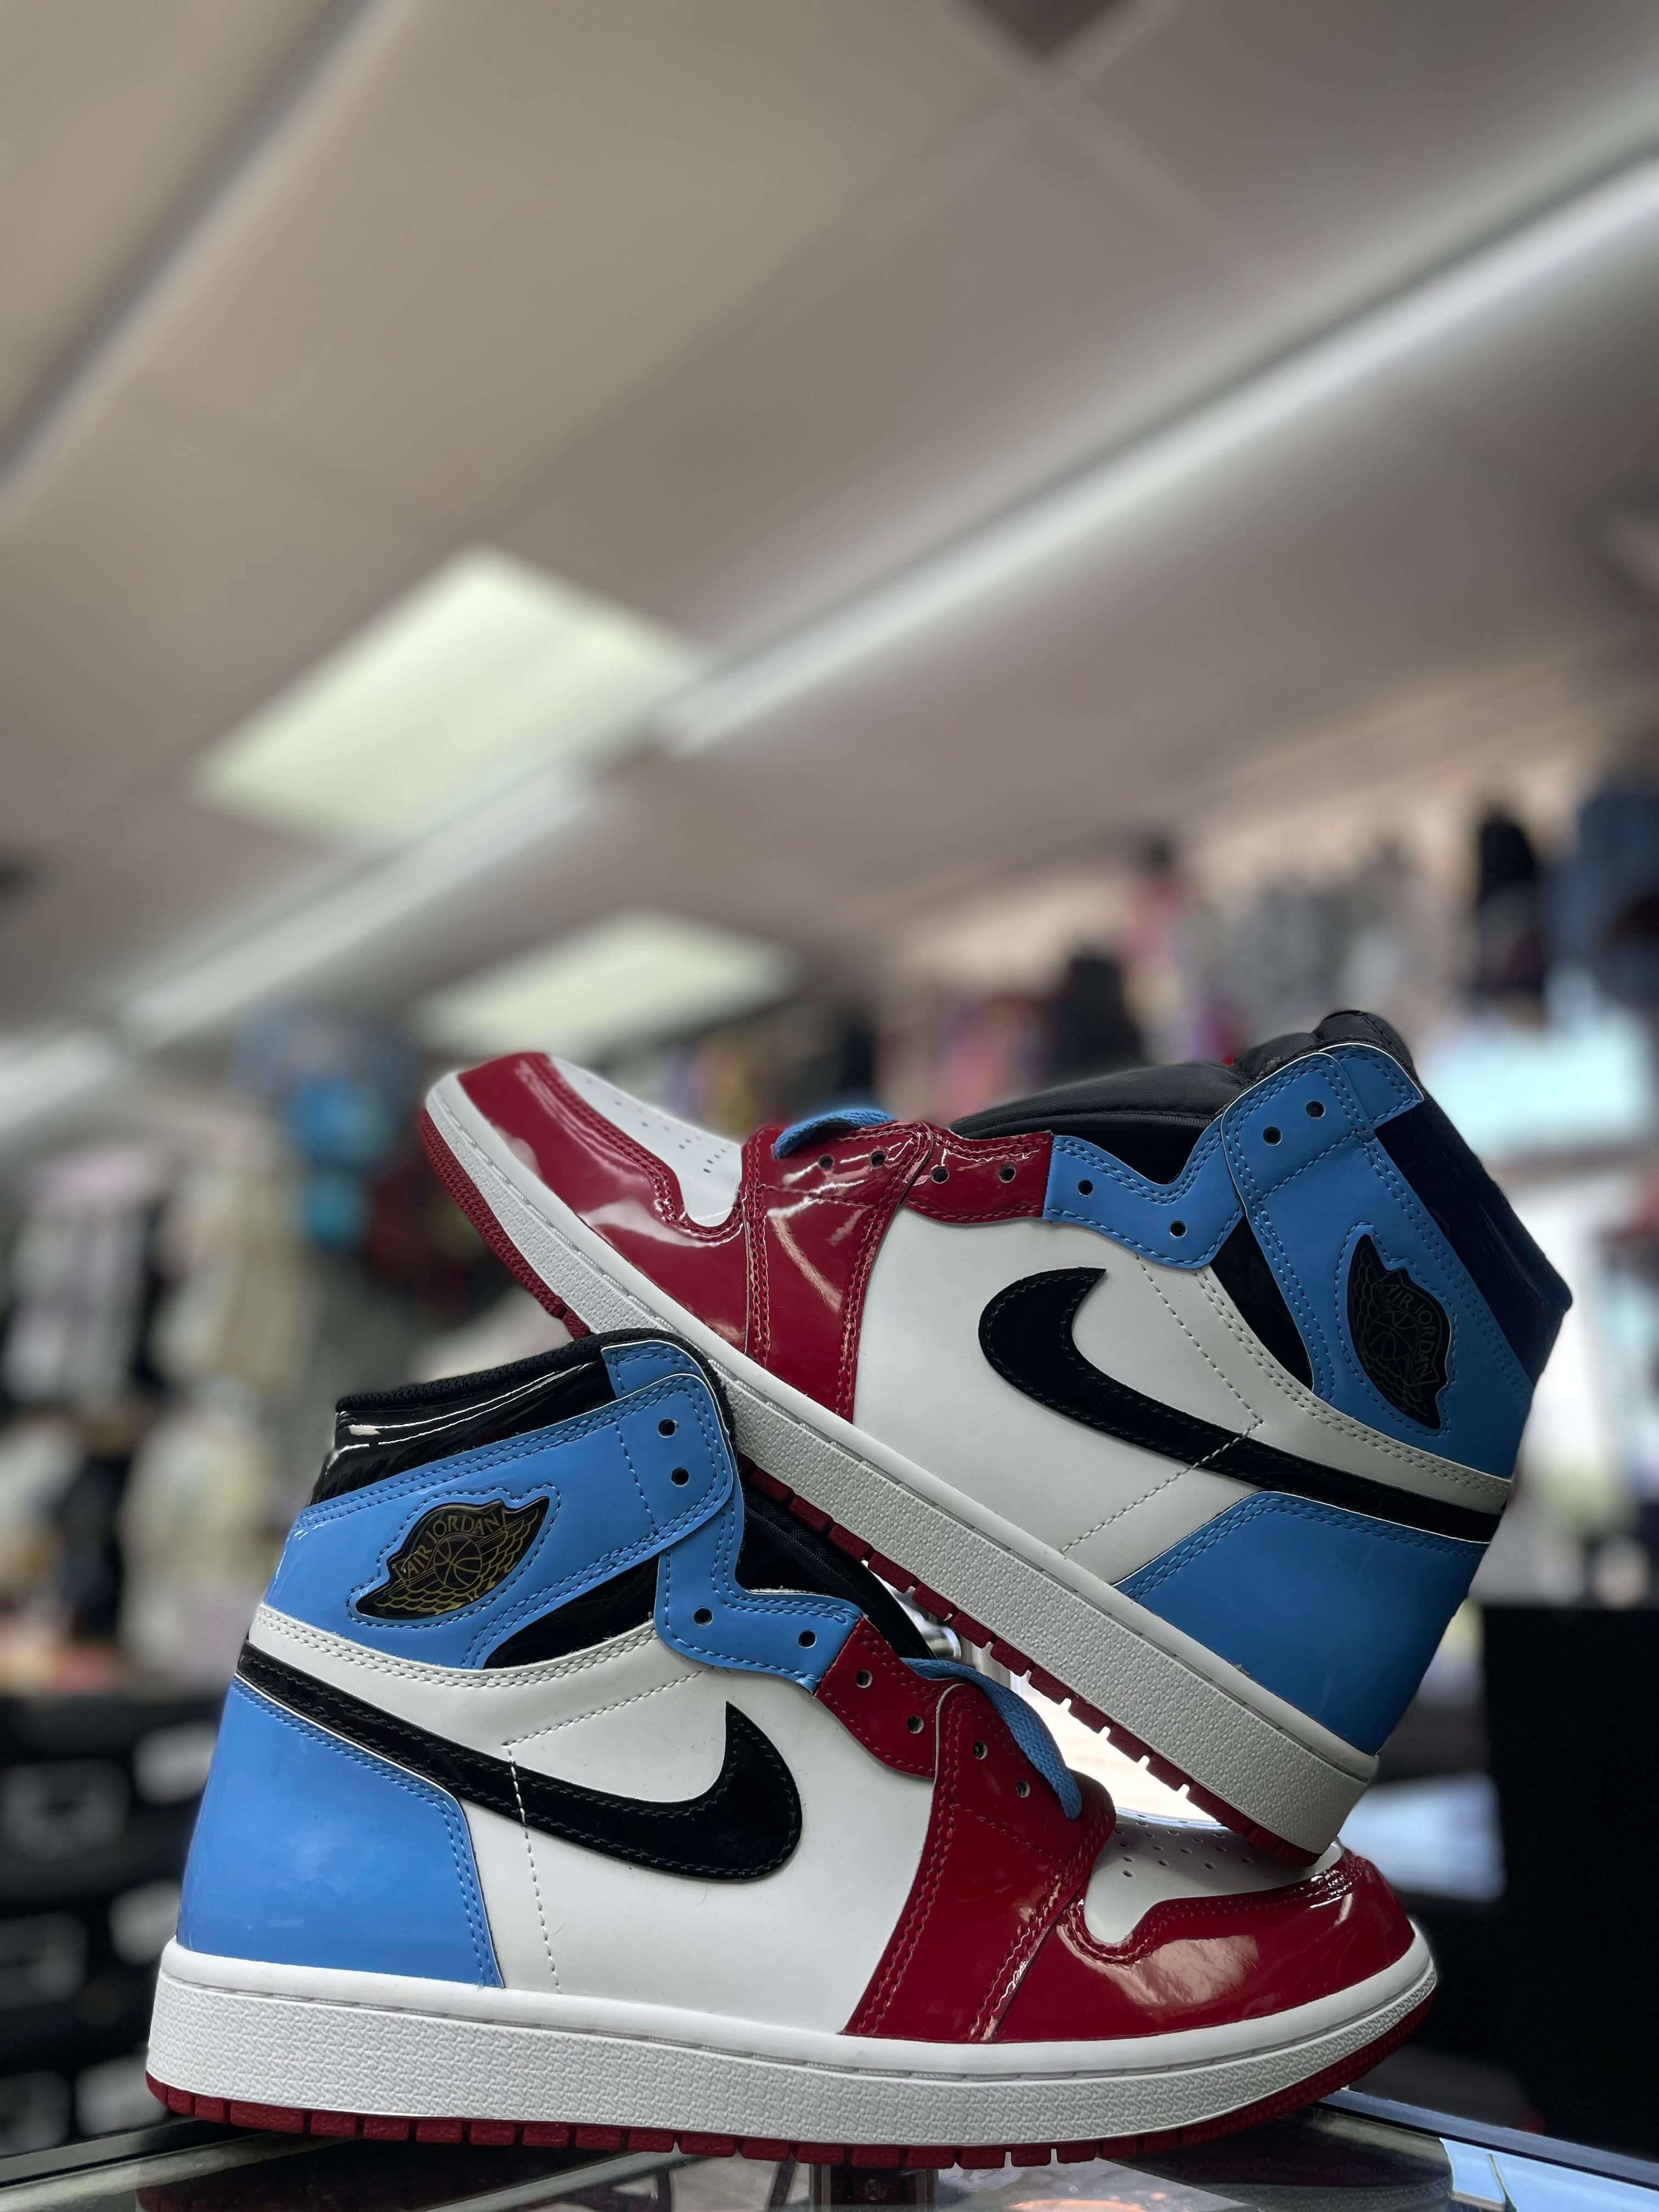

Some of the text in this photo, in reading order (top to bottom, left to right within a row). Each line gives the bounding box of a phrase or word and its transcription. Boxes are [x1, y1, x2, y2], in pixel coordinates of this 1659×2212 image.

[1385, 1283, 1436, 1379] AIR JORDAN
[408, 1512, 500, 1577] AIR JORDAN
